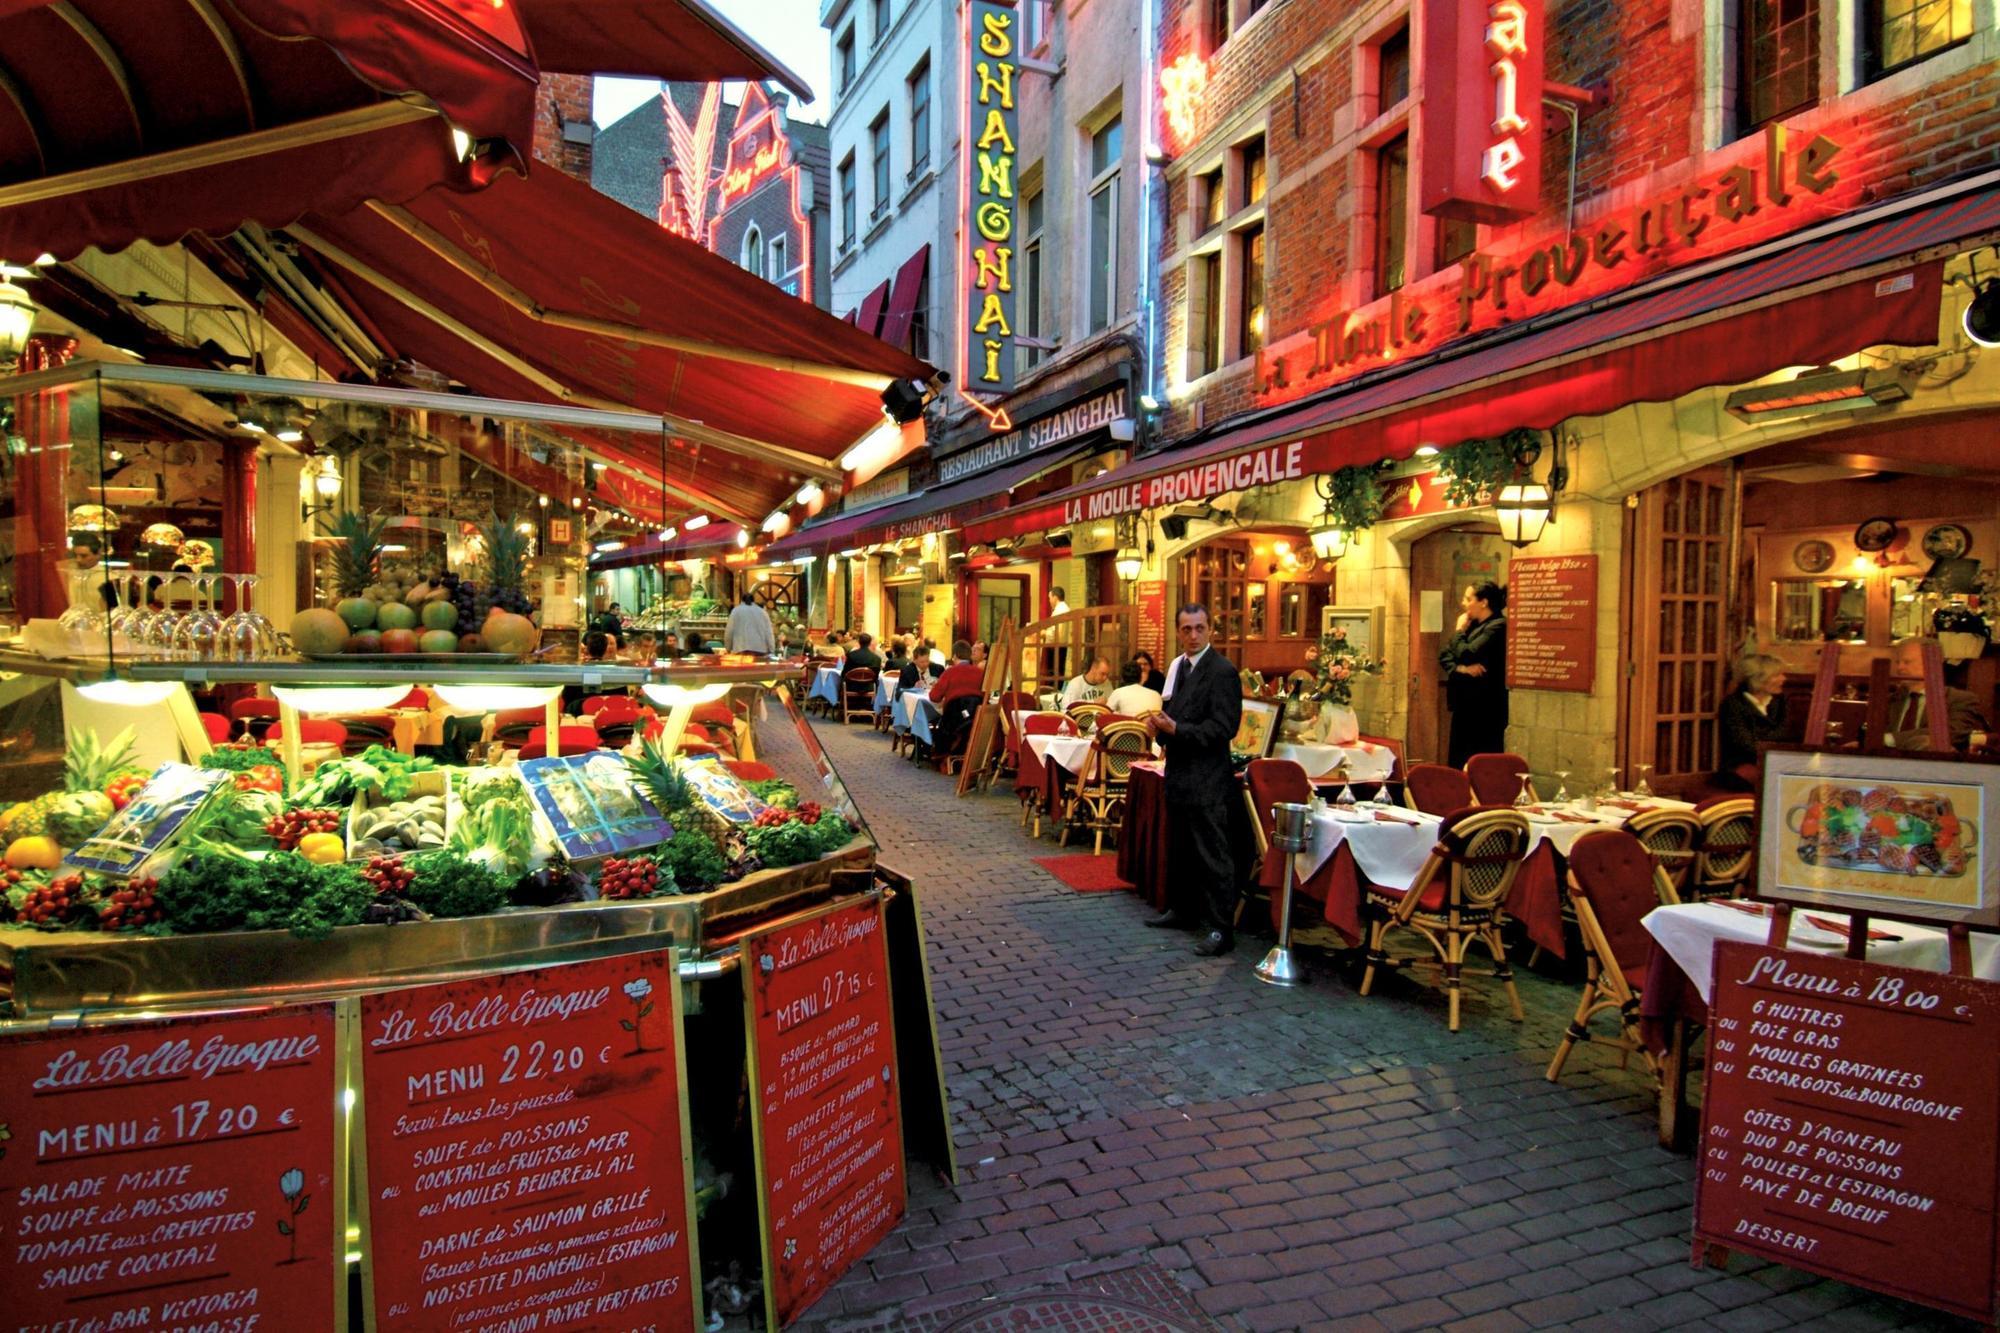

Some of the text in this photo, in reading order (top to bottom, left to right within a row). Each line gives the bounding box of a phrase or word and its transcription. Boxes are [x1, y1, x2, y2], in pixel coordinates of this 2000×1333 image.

[1248, 344, 1289, 397] La
[1307, 290, 1429, 380] Moule
[939, 388, 1126, 482] RESTAURANT SHANGHAI
[1064, 441, 1303, 524] LA MOULE PROVENCALE
[885, 512, 951, 541] LE SHANGHAI
[777, 937, 798, 968] La
[801, 921, 838, 960] Belle
[1736, 955, 1842, 996] Menu
[371, 1008, 417, 1047] La
[423, 994, 511, 1038] Belle
[777, 992, 818, 1031] MENU
[1752, 999, 1764, 1014] 6
[1718, 1017, 1739, 1031] ou
[1793, 1030, 1840, 1050] GRAS
[33, 1050, 91, 1090] La
[90, 1038, 194, 1084] Belle
[799, 1048, 829, 1077] AVOCAT
[1715, 1039, 1736, 1053] ou
[1749, 1042, 1822, 1071] MOULES
[408, 1064, 485, 1101] MENU
[783, 1071, 820, 1105] MOULES
[1713, 1060, 1965, 1121] ou ESCARGOTS de BOURGOGNE
[442, 1105, 482, 1127] tous
[485, 1098, 509, 1119] les
[551, 1087, 576, 1104] de
[786, 1100, 837, 1142] BROCHETTE
[39, 1119, 138, 1156] MENU
[413, 1140, 469, 1169] SOUPE
[468, 1138, 496, 1158] de
[1709, 1124, 1730, 1138] ou
[1743, 1130, 1777, 1150] DUO
[1782, 1140, 1811, 1158] DE
[1799, 1120, 1903, 1157] D'AGNEAU
[380, 1184, 402, 1200] ou
[487, 1156, 509, 1175] de
[583, 1130, 630, 1156] MER
[1708, 1147, 1729, 1161] ou
[1741, 1152, 1811, 1183] POULET
[1823, 1173, 1935, 1213] L'ESTRAGON
[18, 1175, 108, 1206] SALADE
[418, 1200, 442, 1218] ou
[441, 1179, 512, 1213] MOULES
[516, 1164, 580, 1196] BEURRE
[1705, 1168, 1891, 1226] ou PAVÉ DE BOEUF
[16, 1210, 257, 1265] TOMATE aux CREVETTES
[18, 1206, 102, 1236] SOUPE
[100, 1203, 128, 1225] de
[418, 1227, 482, 1260] DARNE
[482, 1223, 506, 1244] de
[510, 1203, 587, 1239] SAUMON
[1734, 1219, 1819, 1254] DESSERT
[38, 1260, 110, 1291] SAUCE
[106, 1306, 151, 1332] BAR
[388, 1302, 411, 1317] ou
